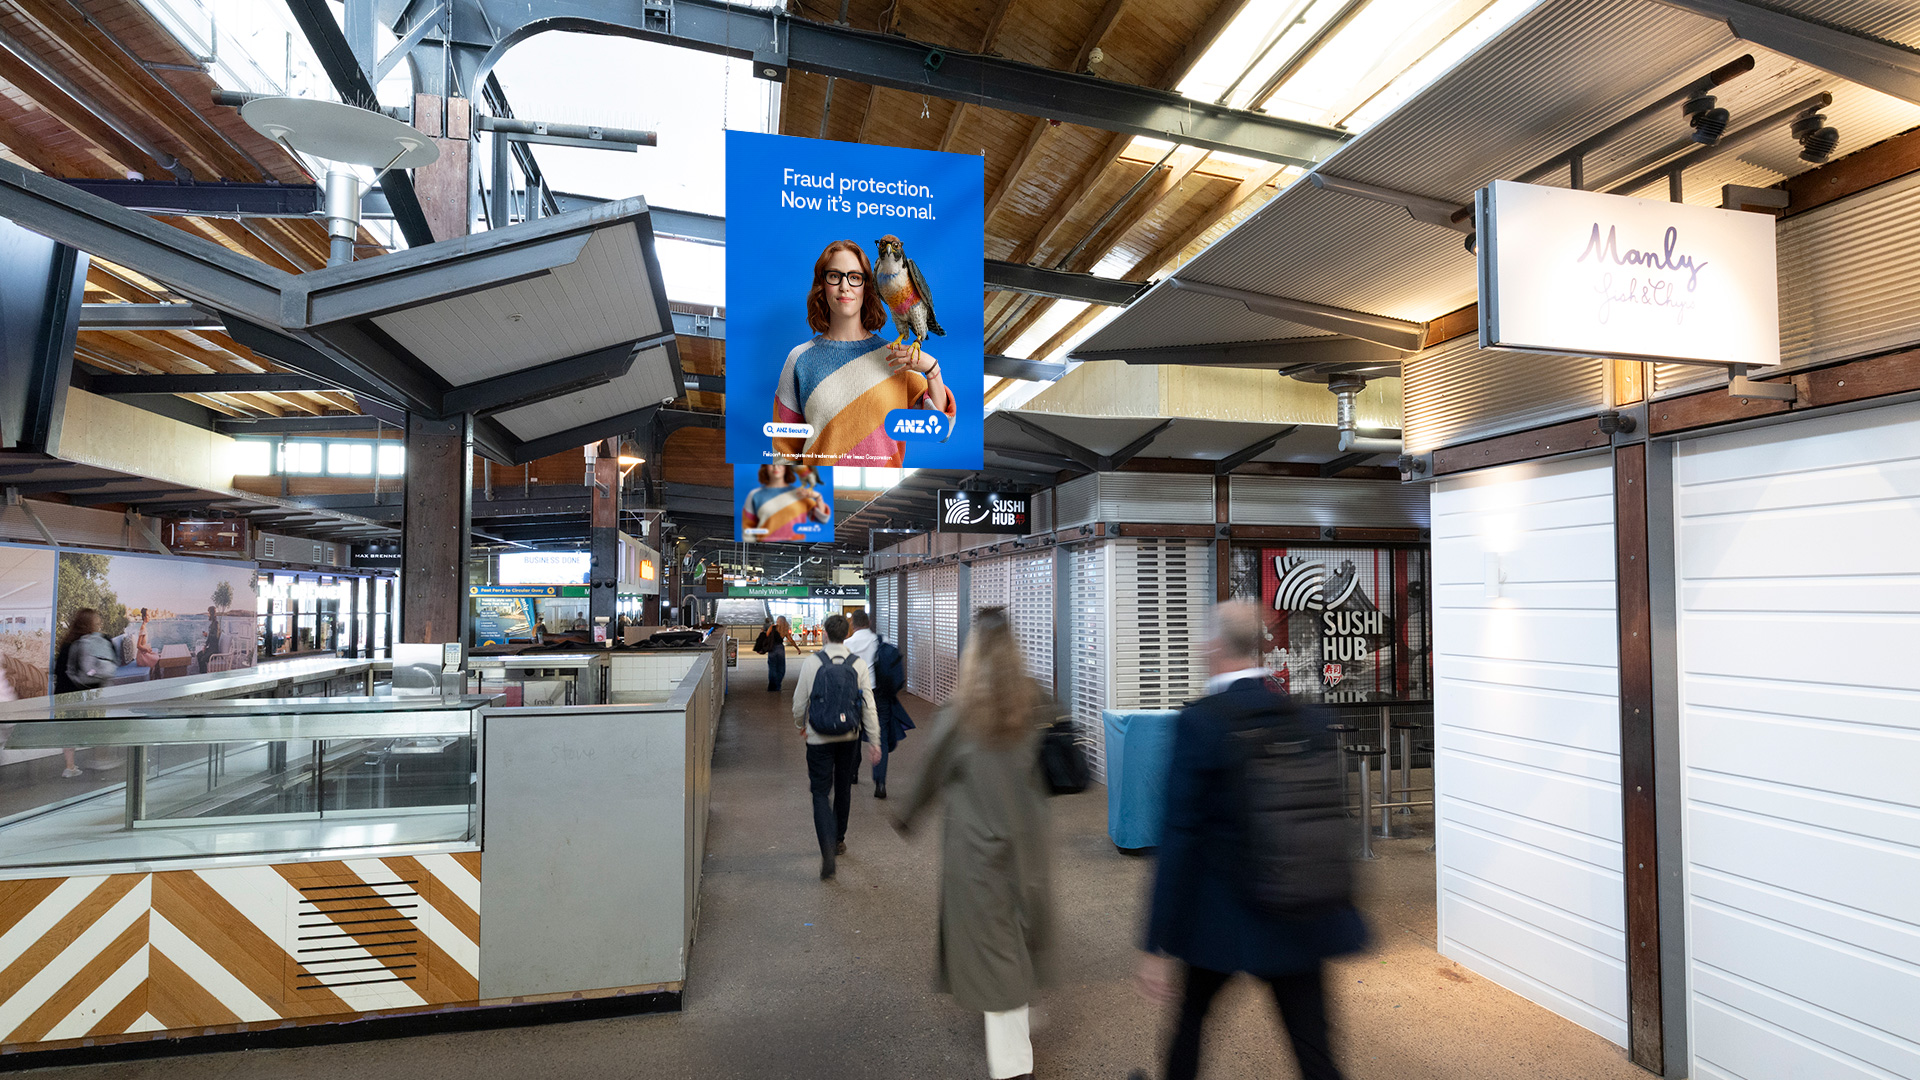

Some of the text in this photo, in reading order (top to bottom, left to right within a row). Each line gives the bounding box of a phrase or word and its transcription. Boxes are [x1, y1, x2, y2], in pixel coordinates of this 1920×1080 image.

[783, 168, 934, 198] Fraud protection.
[781, 190, 822, 211] Now
[856, 201, 936, 221] personal.
[1577, 222, 1708, 293] Manly
[1594, 271, 1638, 325] Fish
[1641, 284, 1651, 306] &
[788, 427, 809, 435] Security
[893, 419, 926, 434] ANZ
[791, 452, 814, 460] registered
[992, 499, 1025, 513] SUSHI
[991, 512, 1016, 526] HUB
[524, 556, 580, 564] BUSINESS DONE
[748, 588, 768, 596] Manly
[1323, 610, 1383, 636] SUSHI
[1323, 637, 1368, 661] HUB
[534, 698, 555, 706] fresh
